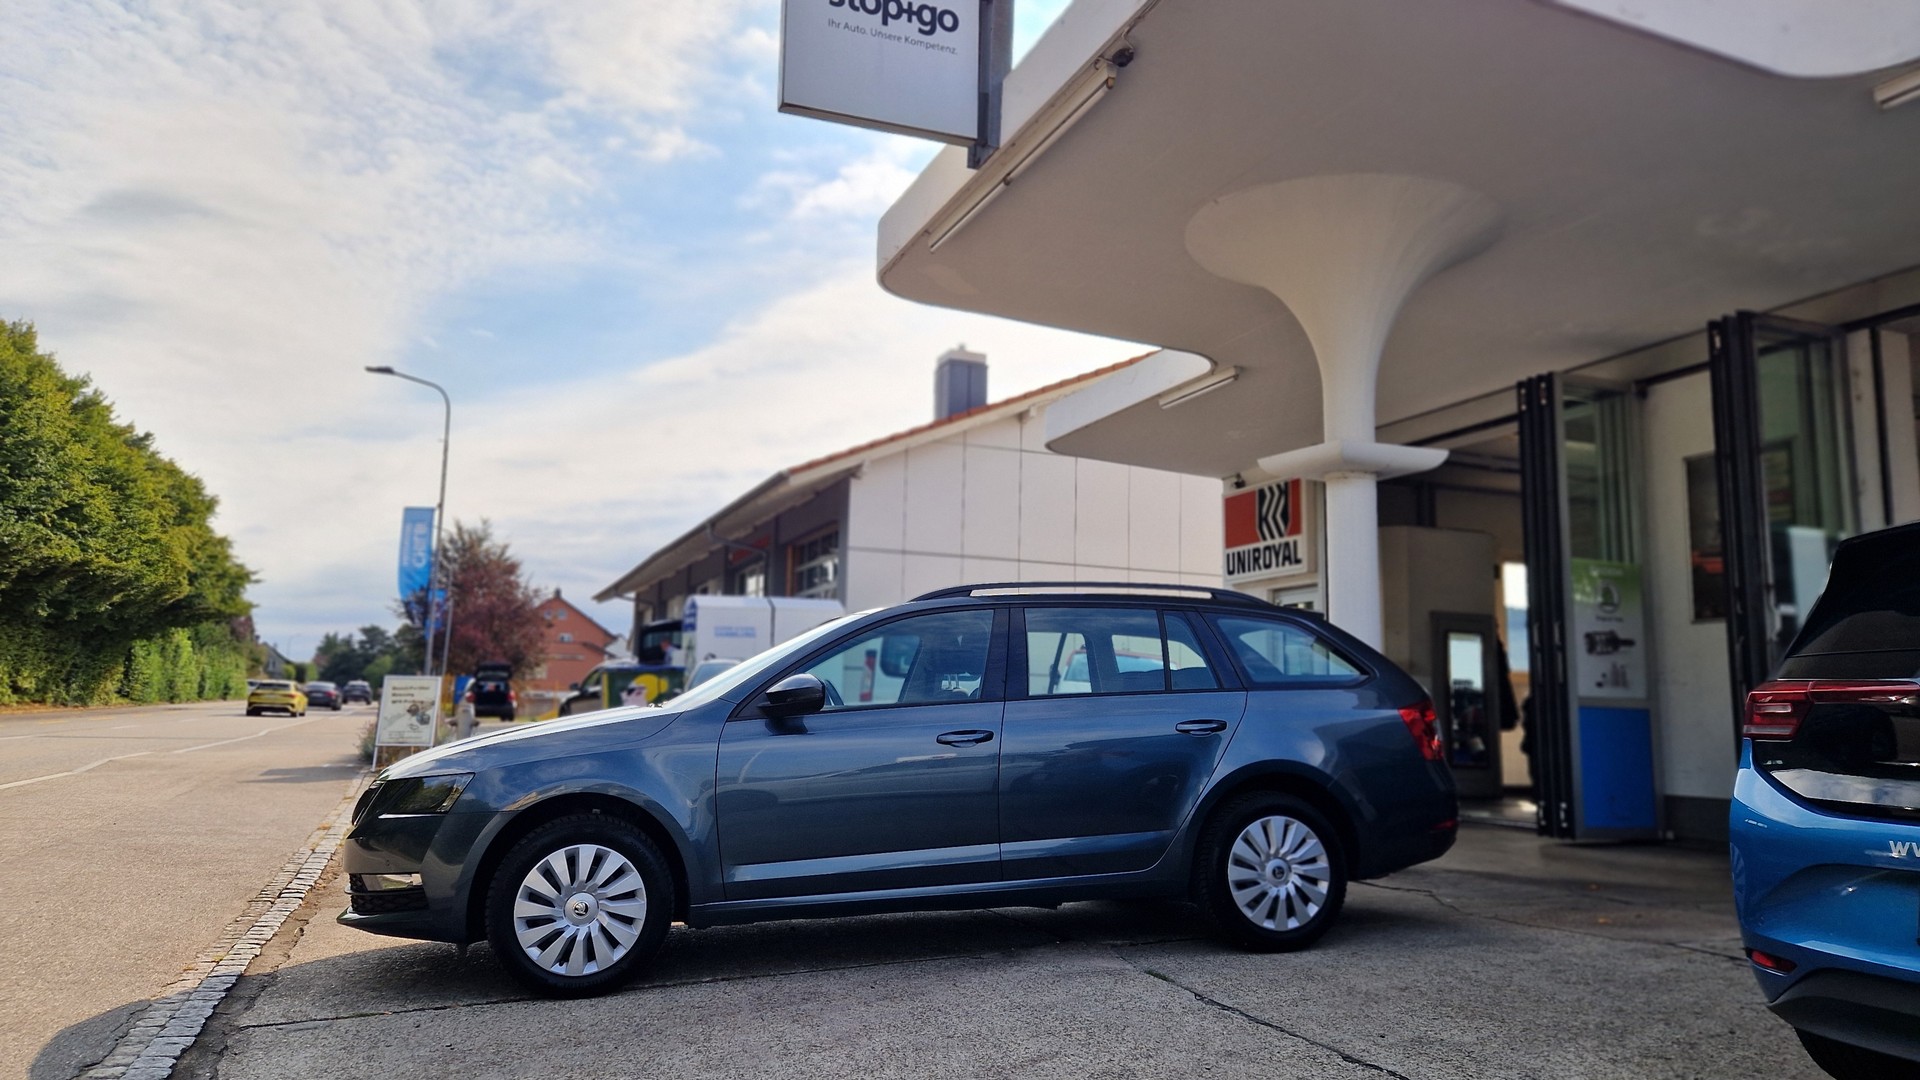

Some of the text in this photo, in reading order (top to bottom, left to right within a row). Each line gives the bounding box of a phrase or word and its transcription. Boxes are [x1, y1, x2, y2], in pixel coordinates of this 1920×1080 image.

[827, 18, 958, 55] Ihr Auto. Unsere Kompetenz.
[1226, 540, 1302, 576] UNIROYAL
